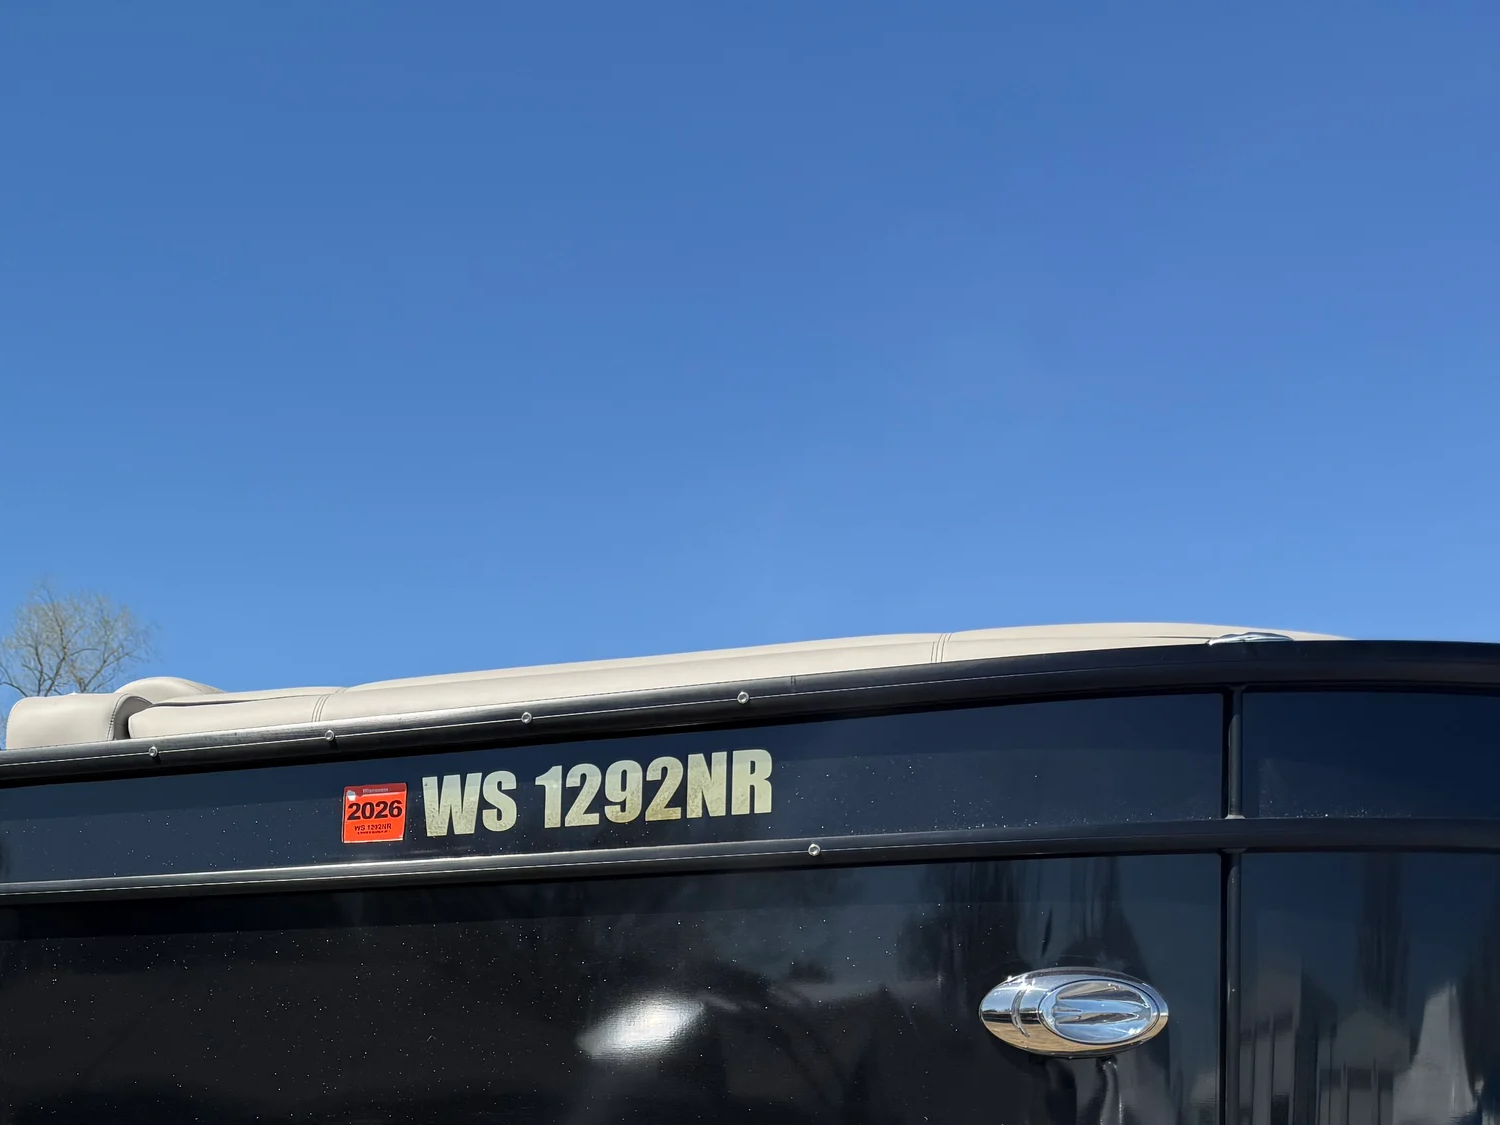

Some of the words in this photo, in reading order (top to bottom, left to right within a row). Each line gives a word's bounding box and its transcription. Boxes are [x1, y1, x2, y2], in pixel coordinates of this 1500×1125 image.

[347, 799, 403, 821] 2026
[422, 770, 517, 837] WS
[535, 749, 773, 829] 1292NR
